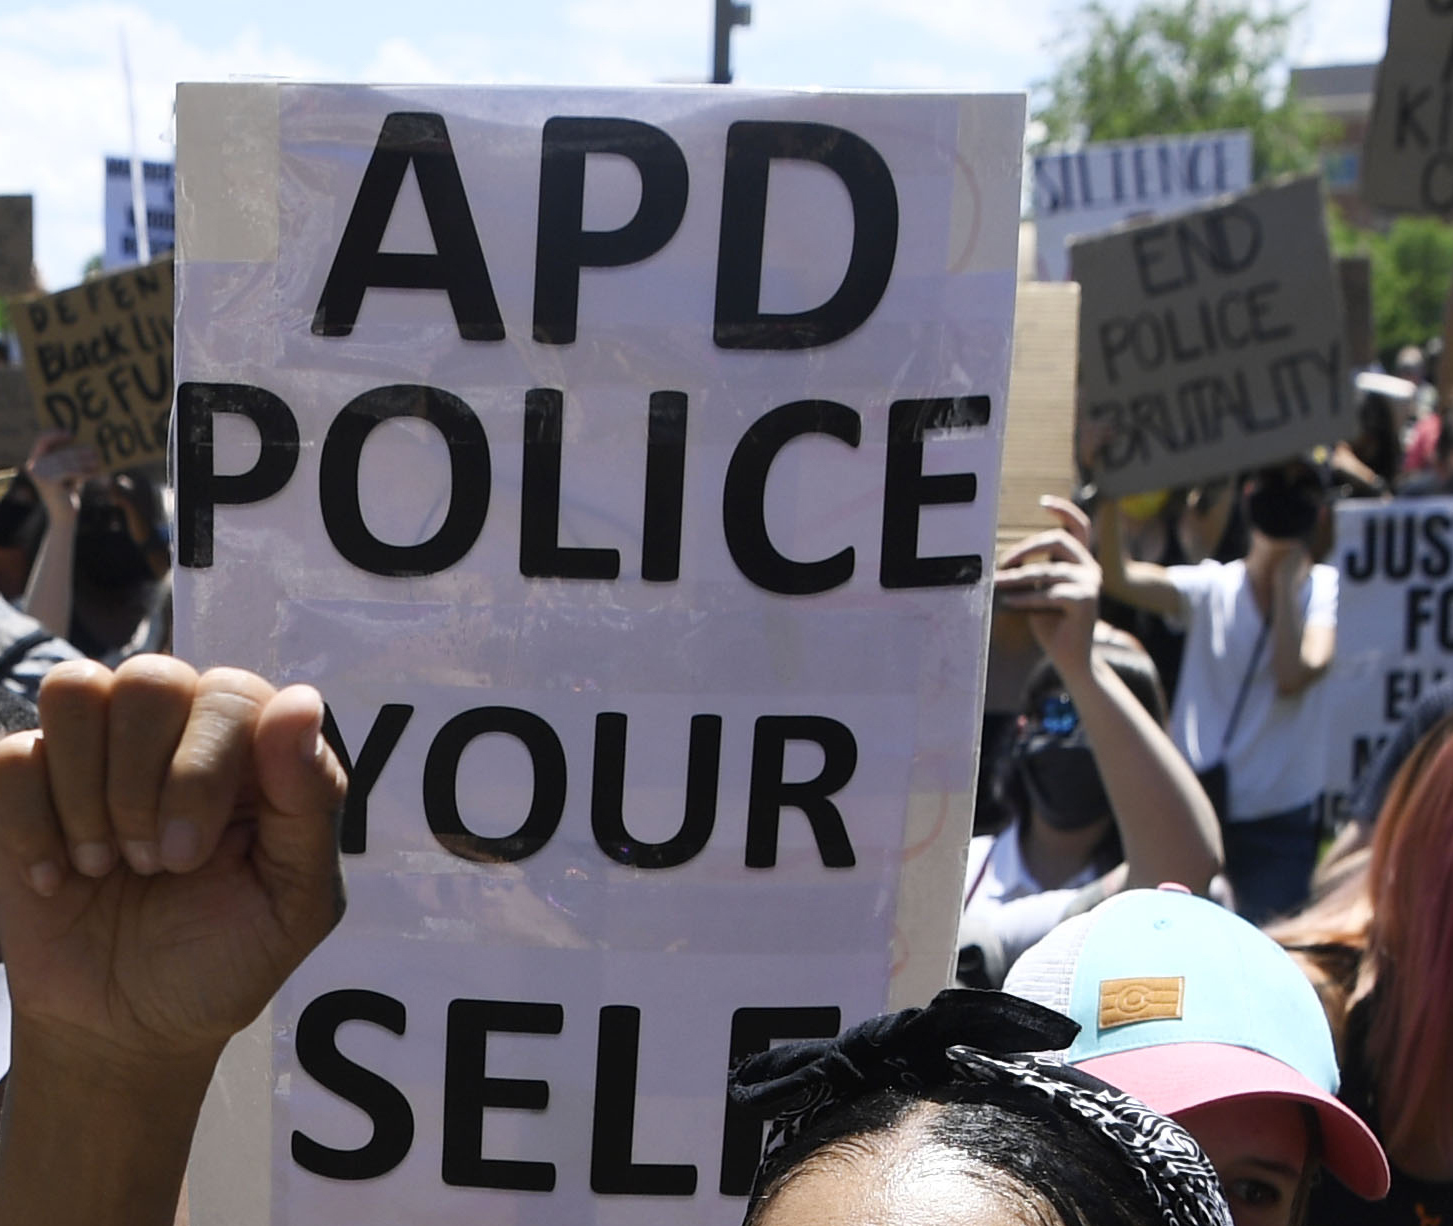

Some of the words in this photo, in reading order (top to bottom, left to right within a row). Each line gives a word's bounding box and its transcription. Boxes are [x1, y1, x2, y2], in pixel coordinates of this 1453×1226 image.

[310, 110, 900, 350] APD
[1034, 140, 1234, 213] SILENCE
[29, 262, 175, 334] DEFEN
[1132, 208, 1265, 297] END
[1099, 280, 1299, 385] POLICE
[1089, 341, 1344, 472] BRUTALITY
[176, 381, 992, 595] POLICE
[323, 702, 858, 870] YOUR
[291, 988, 842, 1197] SELF
